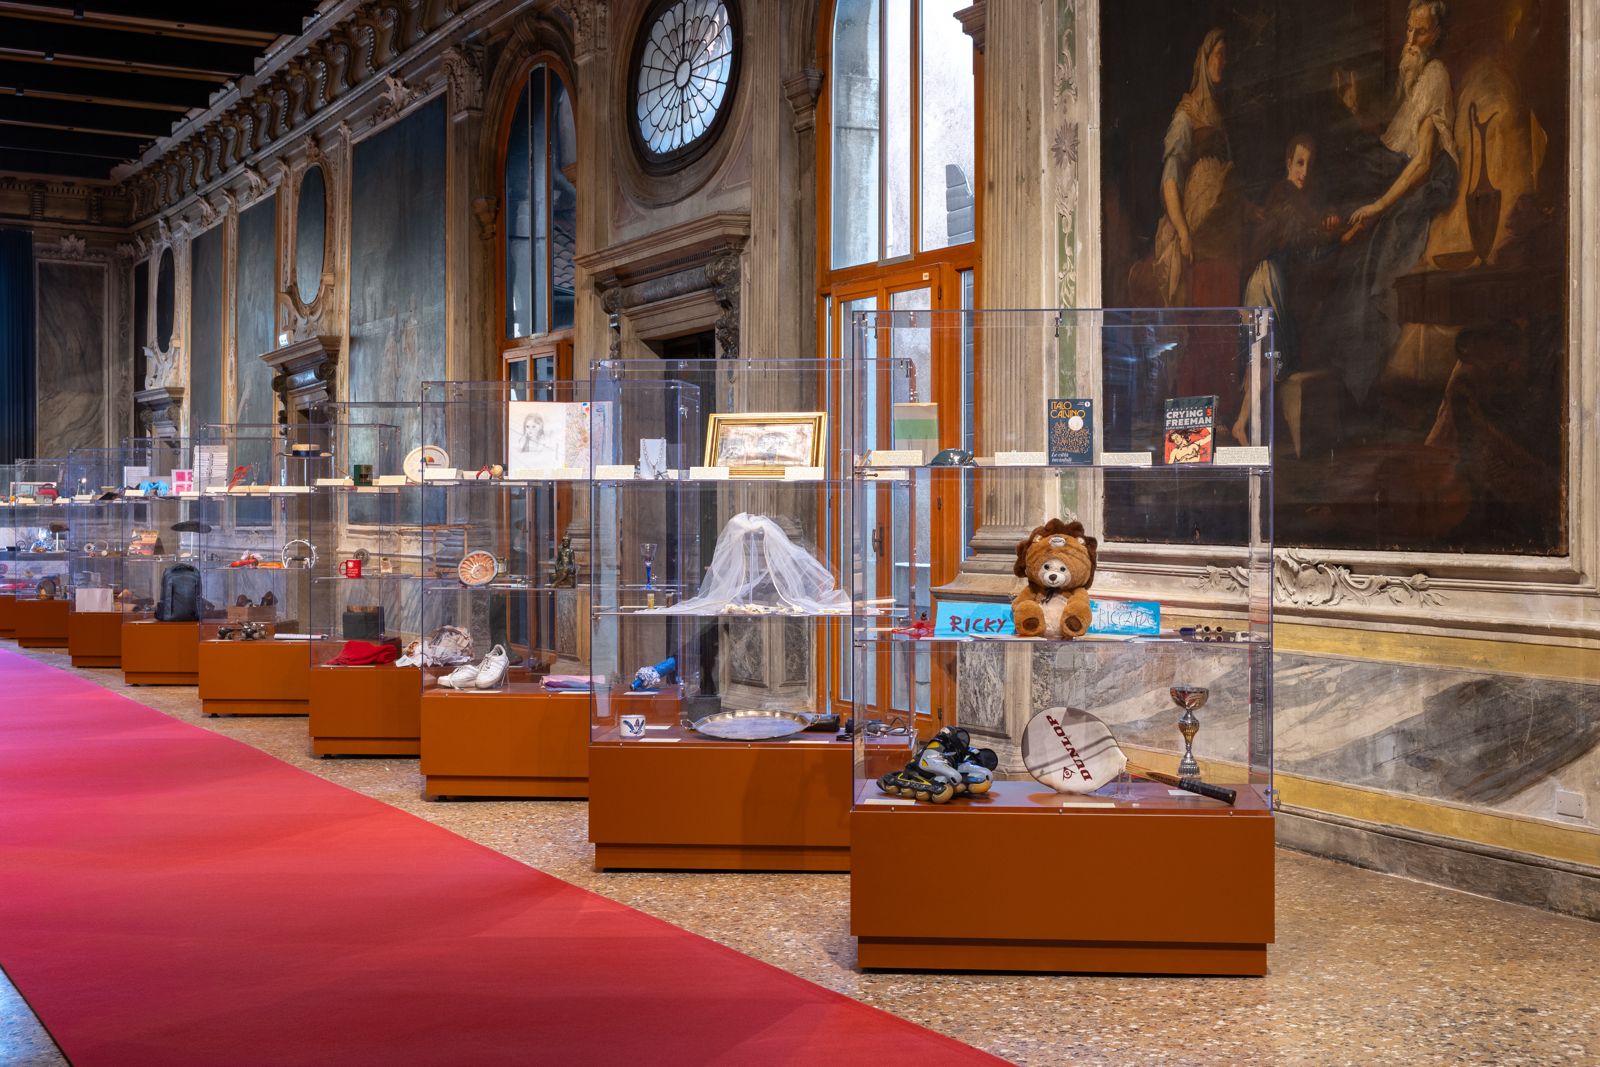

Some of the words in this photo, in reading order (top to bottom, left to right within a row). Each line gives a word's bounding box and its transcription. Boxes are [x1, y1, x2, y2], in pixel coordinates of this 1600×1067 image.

[1050, 409, 1086, 419] CALVINO
[1166, 409, 1204, 419] CRYING
[1166, 416, 1212, 427] FREEMAN
[949, 615, 1007, 633] RICKY
[1046, 715, 1093, 781] DUNLOP
